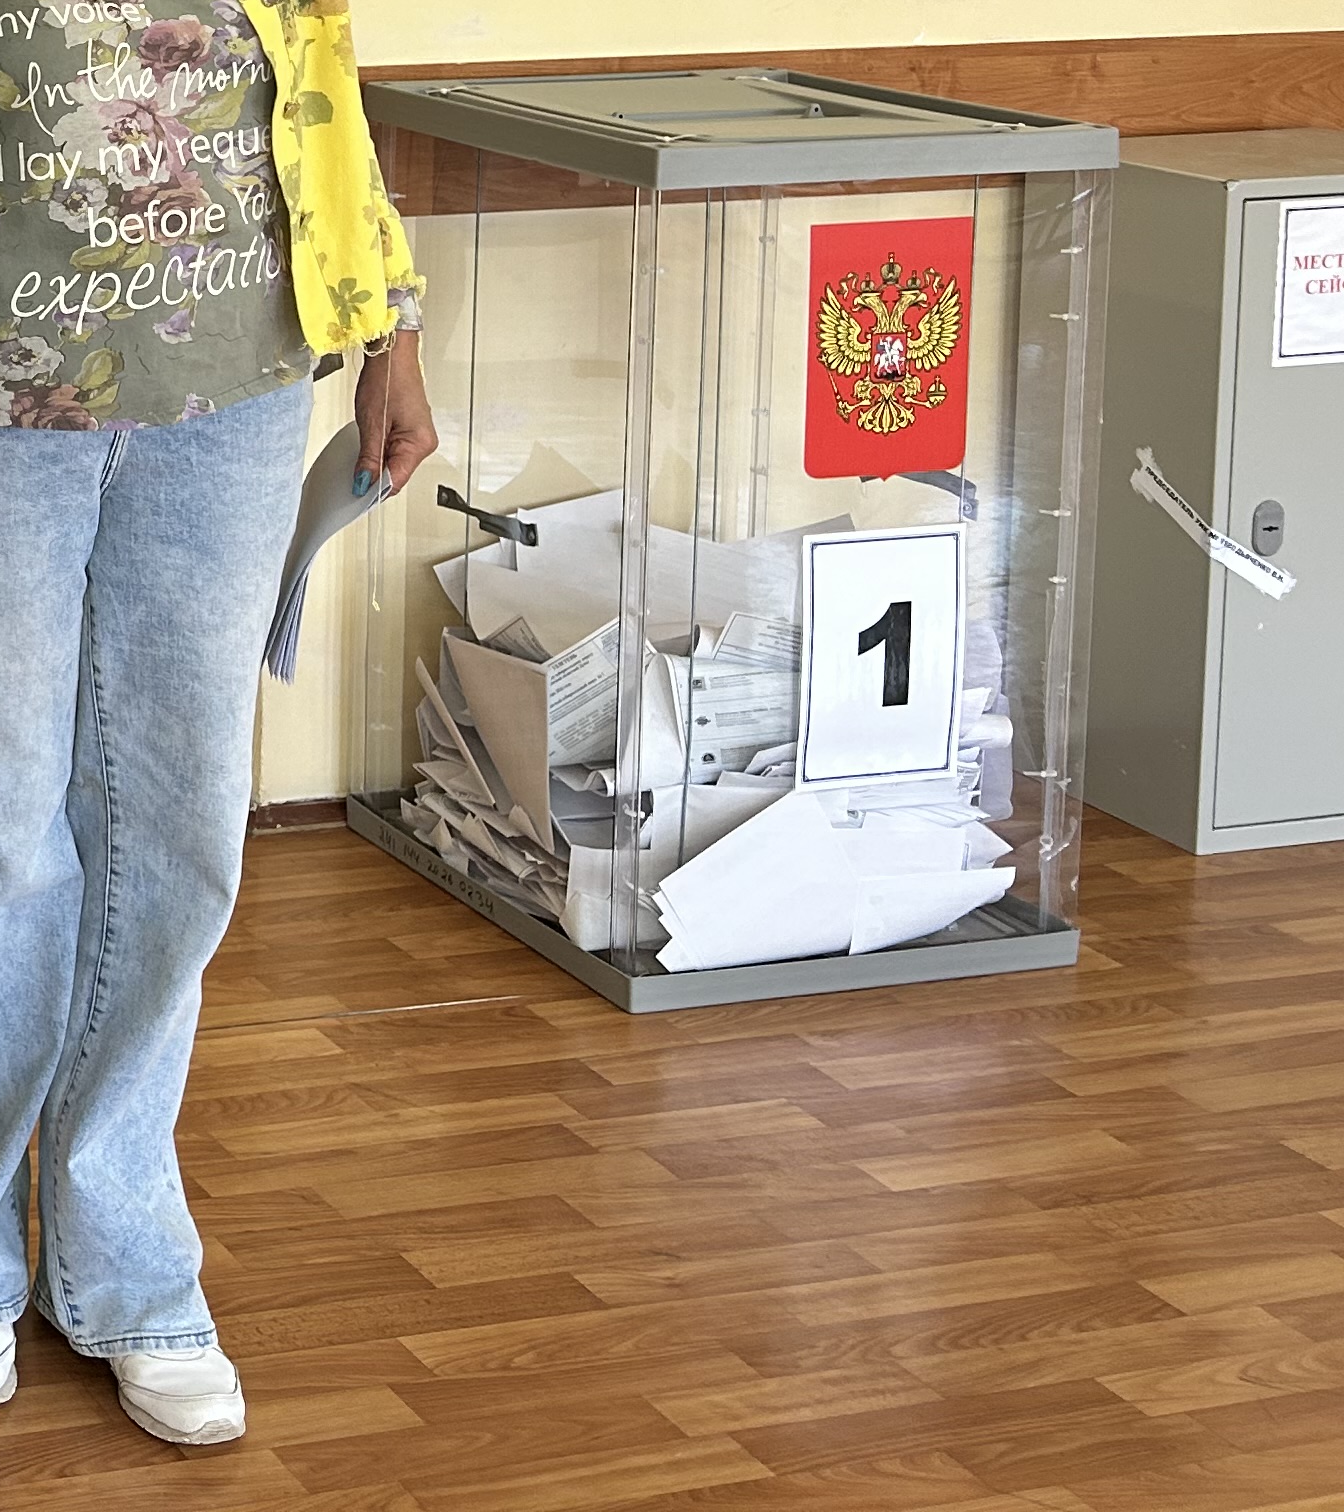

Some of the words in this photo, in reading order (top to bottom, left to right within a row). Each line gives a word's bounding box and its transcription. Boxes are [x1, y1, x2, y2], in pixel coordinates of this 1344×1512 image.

[11, 61, 76, 138] In
[77, 38, 159, 102] the
[18, 141, 83, 190] lay
[99, 140, 164, 181] my
[87, 199, 227, 248] before
[1305, 275, 1344, 295] СЕЙ
[1145, 465, 1195, 519] ПРЕДСЕДАТЕЛЬ
[858, 601, 912, 707] 1
